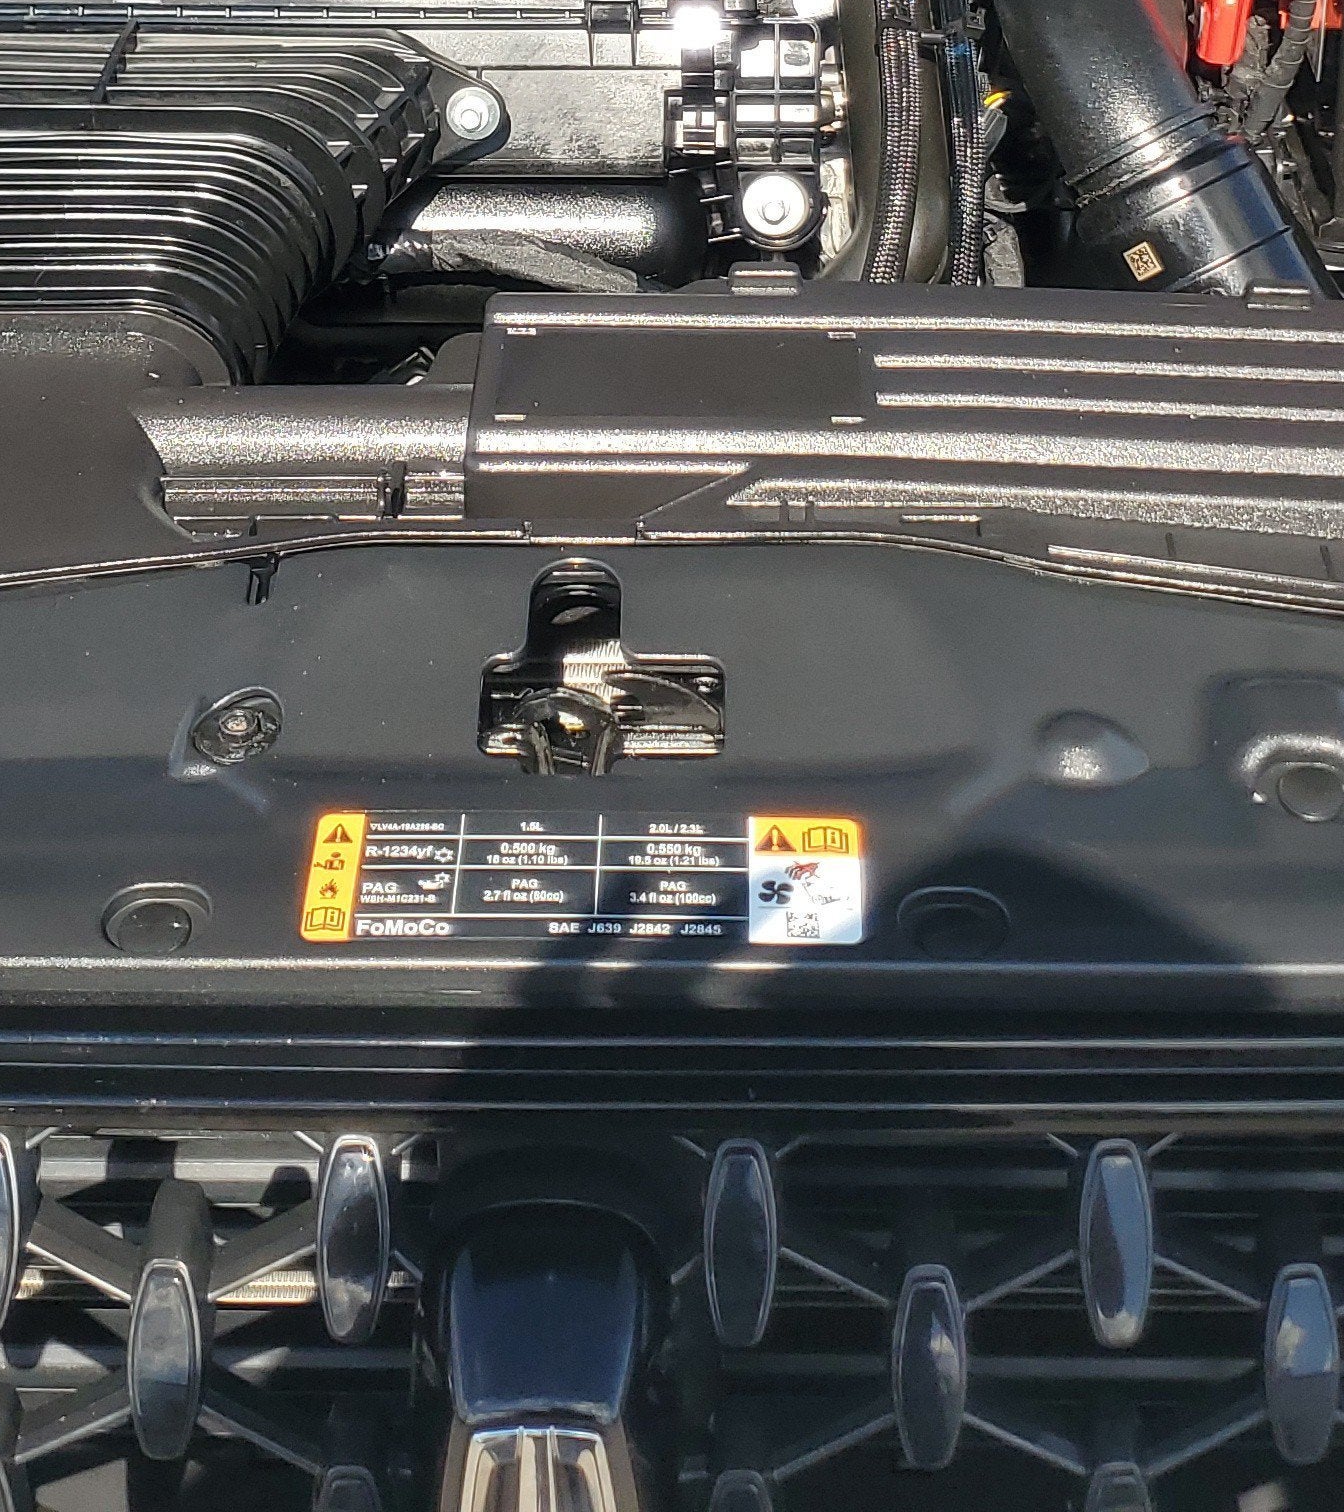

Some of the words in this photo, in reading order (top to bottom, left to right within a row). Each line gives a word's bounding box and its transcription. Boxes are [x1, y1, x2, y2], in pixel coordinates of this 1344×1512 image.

[520, 821, 544, 832] 1.5L
[649, 823, 673, 834] 2.0L
[365, 845, 434, 859] R-1234yf
[500, 842, 536, 854] 0.500
[538, 842, 556, 856] kg
[646, 843, 682, 855] 0.550
[684, 843, 702, 857] kg
[502, 856, 516, 864] oz
[518, 854, 545, 866] (1.10
[547, 854, 568, 866] lbs)
[653, 857, 668, 865] oz
[669, 855, 695, 866] (1.21
[698, 855, 720, 867] lbs)
[362, 882, 398, 894] PAG
[511, 879, 539, 889] PAG
[659, 881, 687, 891] PAG
[483, 890, 501, 901] 2.7
[502, 890, 511, 901] fl
[513, 892, 528, 901] oz
[629, 892, 648, 903] 3.4
[648, 892, 657, 903] fl
[659, 894, 674, 903] oz
[676, 892, 717, 905] (100cc)
[356, 919, 450, 936] FoMoCo
[548, 922, 580, 933] SAE
[587, 922, 622, 934] J639
[629, 923, 671, 934] J2842
[680, 923, 722, 935] J2845
